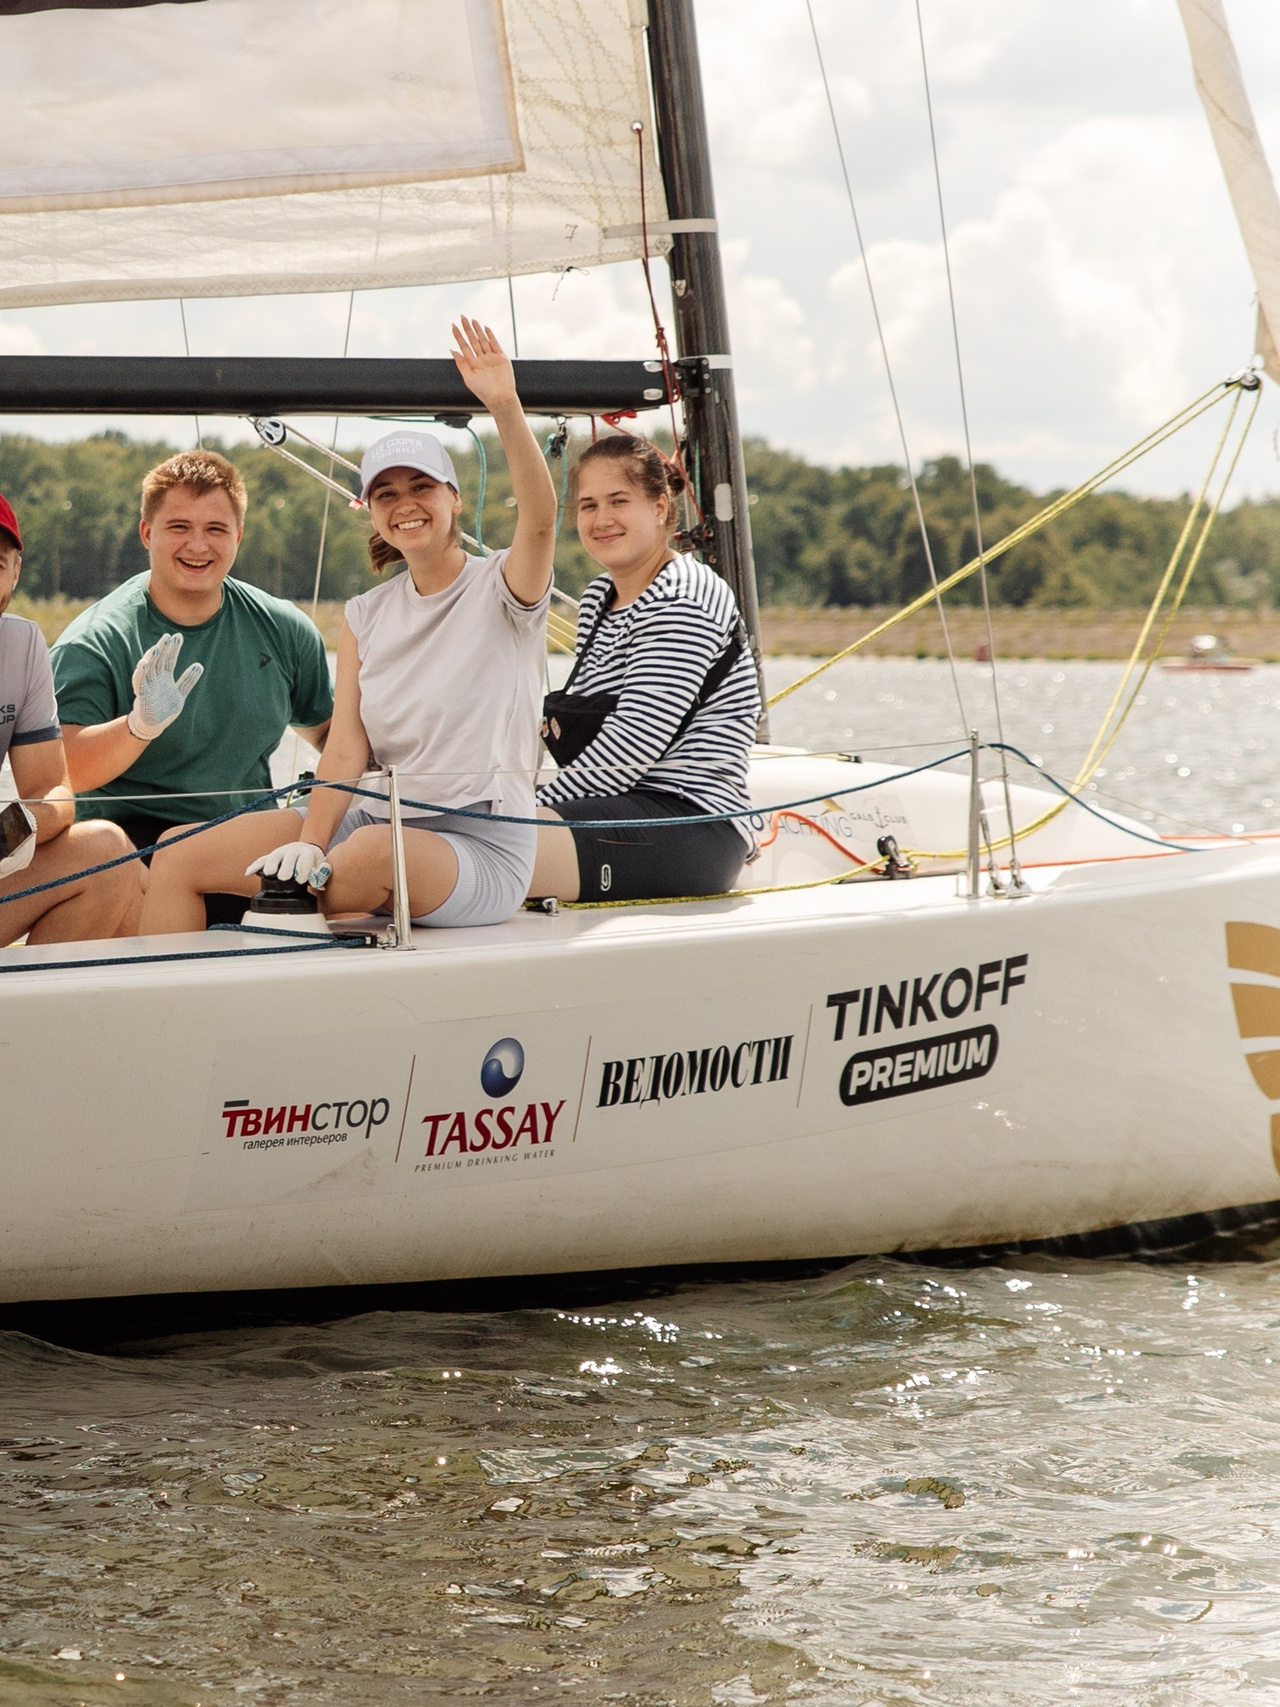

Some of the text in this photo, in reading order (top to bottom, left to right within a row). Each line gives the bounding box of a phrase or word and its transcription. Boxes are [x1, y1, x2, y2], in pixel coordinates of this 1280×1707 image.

[826, 953, 1029, 1042] TINKOFF
[596, 1034, 795, 1109] ВЕДОМОСТИ
[847, 1033, 992, 1096] PREMIUM
[243, 1132, 348, 1150] галерея интерьеров
[421, 1100, 567, 1157] TASSAY
[415, 1149, 556, 1173] PREMIUM DRINKING WATER
